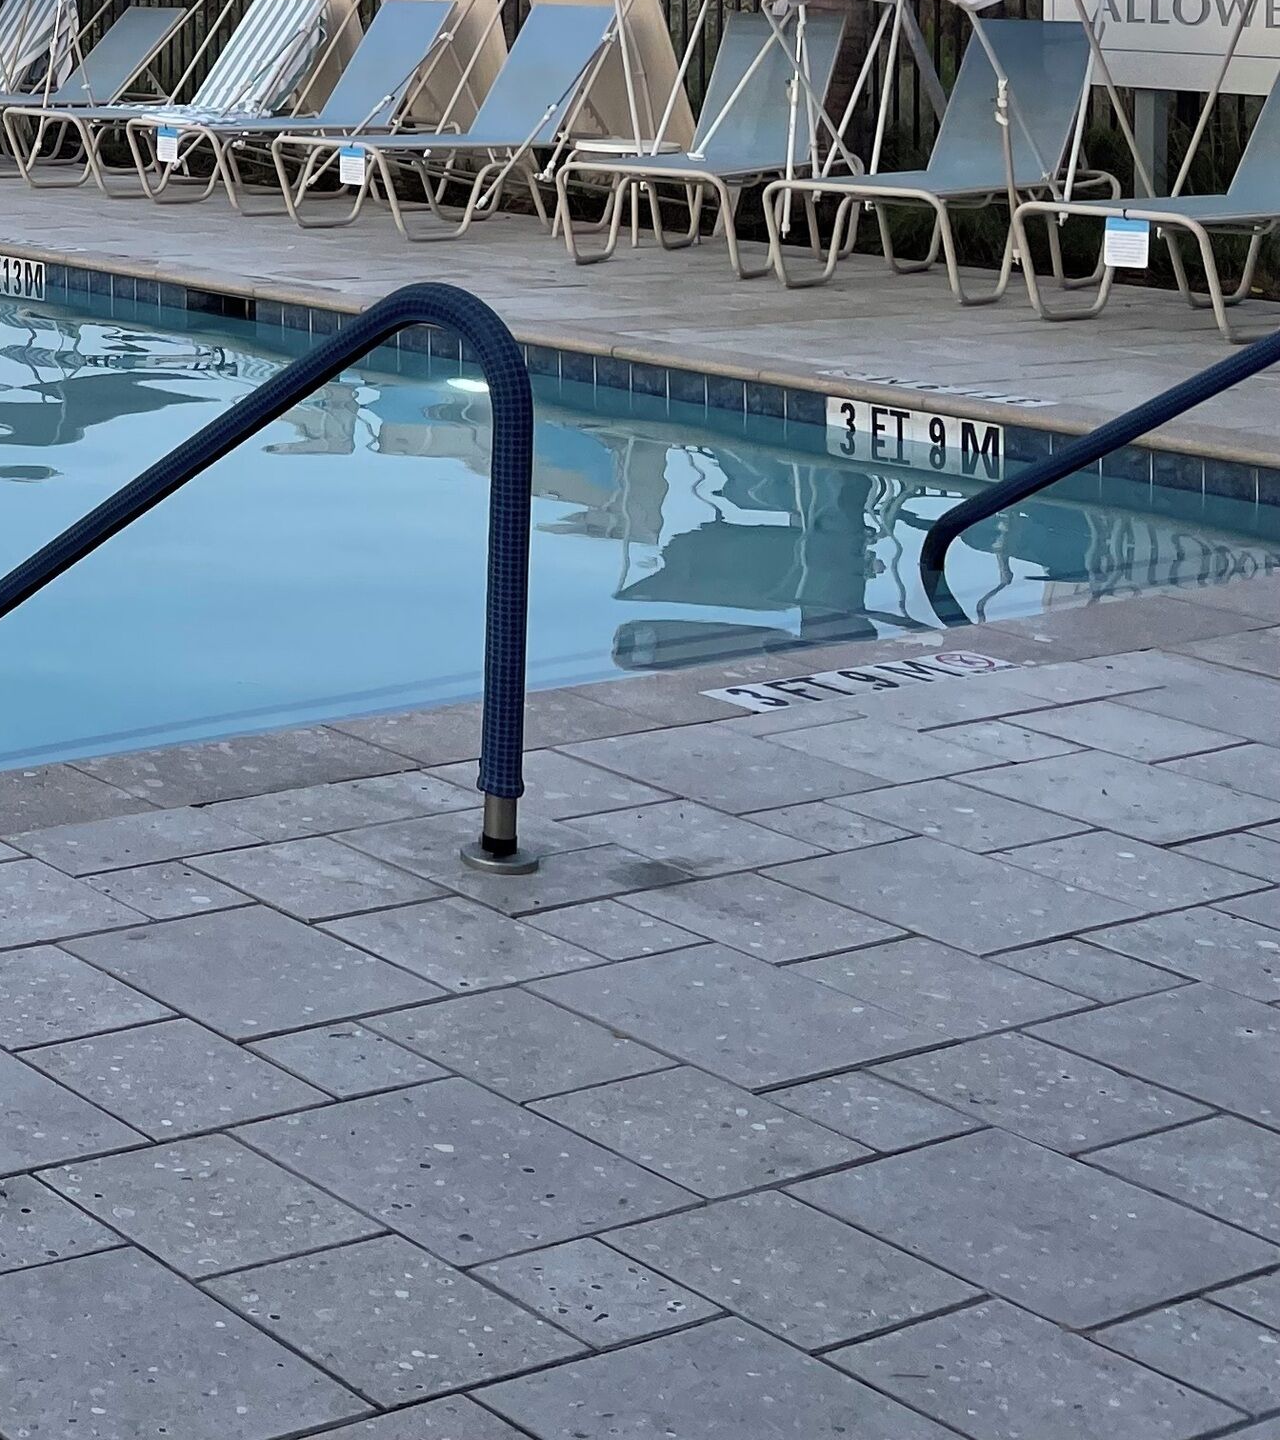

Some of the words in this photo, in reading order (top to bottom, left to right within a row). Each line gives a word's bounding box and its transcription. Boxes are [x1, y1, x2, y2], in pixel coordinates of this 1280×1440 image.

[840, 402, 856, 432] 3
[871, 406, 911, 441] FT
[961, 422, 1000, 457] M
[726, 688, 789, 707] 3
[763, 677, 855, 701] FT
